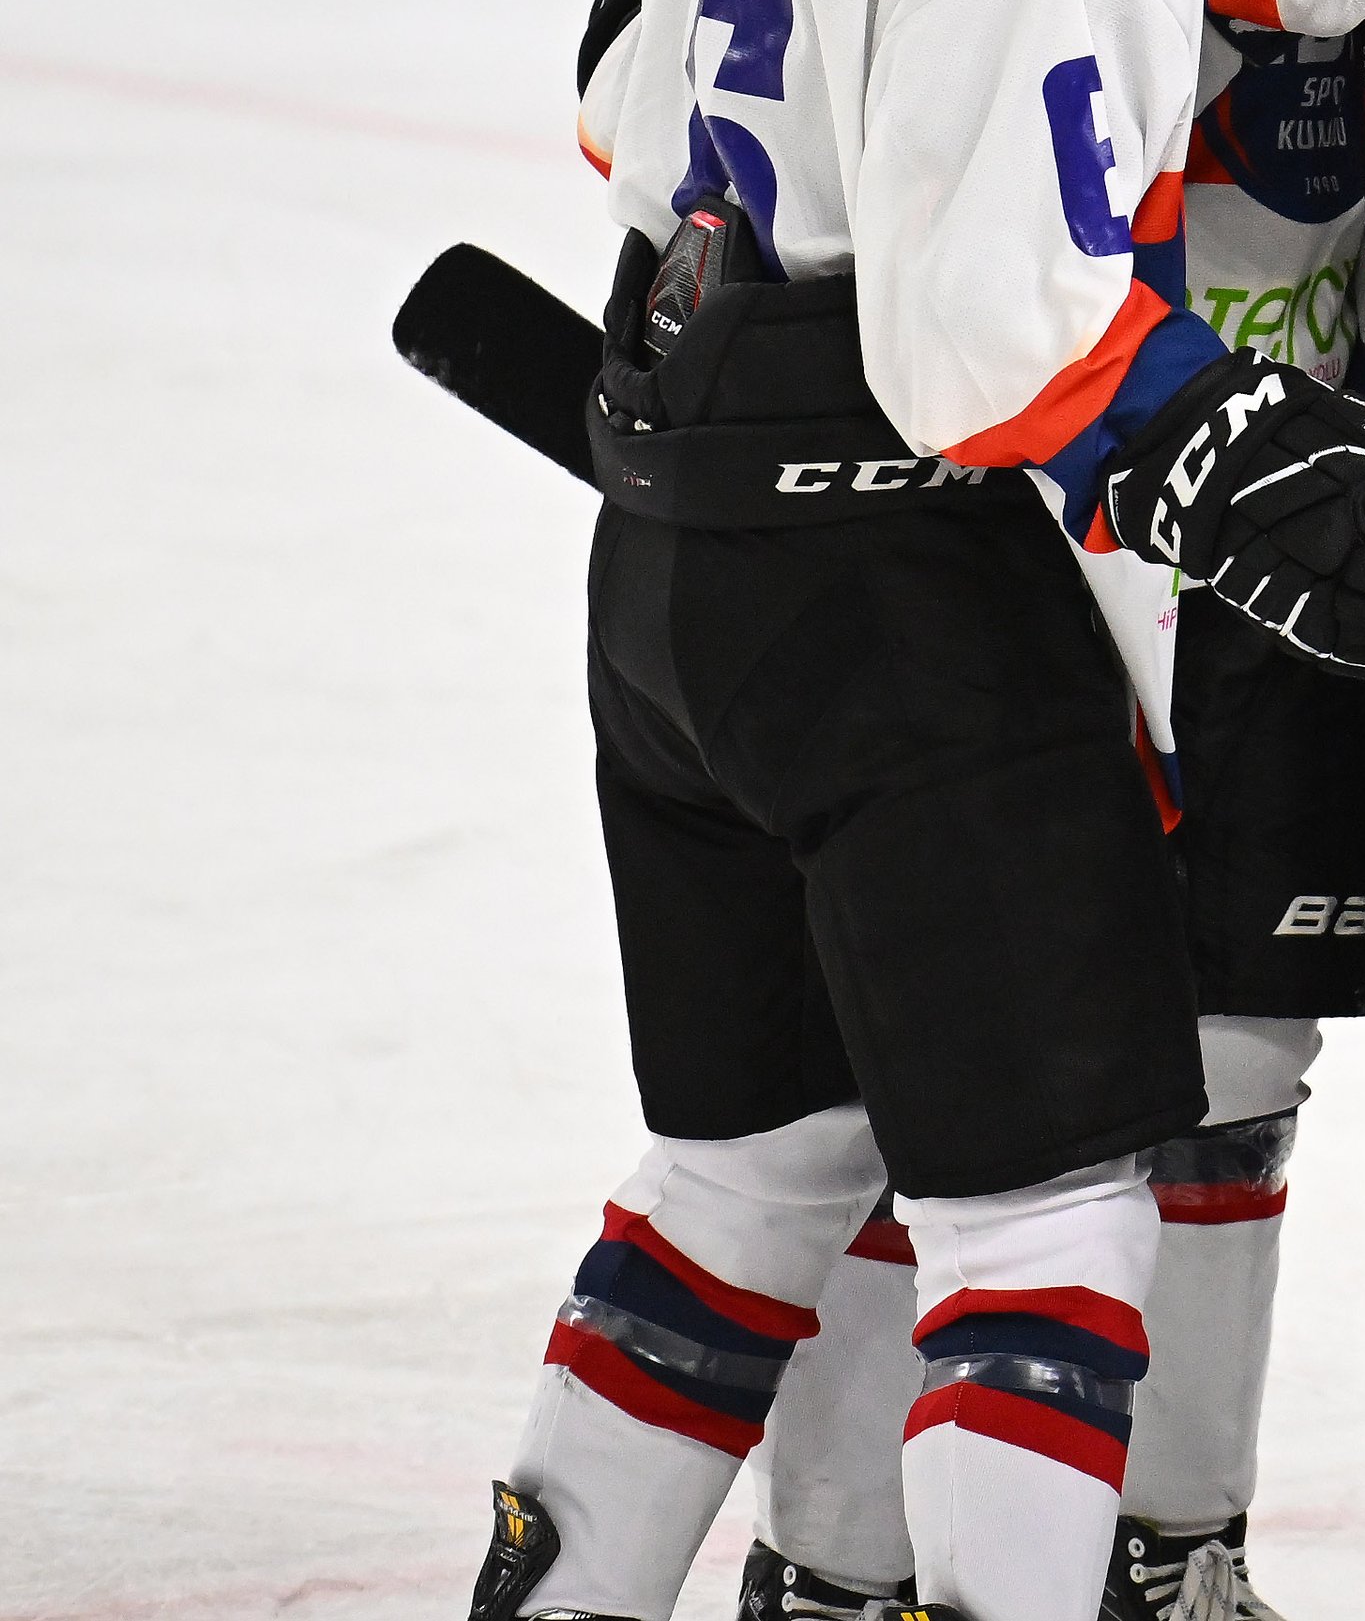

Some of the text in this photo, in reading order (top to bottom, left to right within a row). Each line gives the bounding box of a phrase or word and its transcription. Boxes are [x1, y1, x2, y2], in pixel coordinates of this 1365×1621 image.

[652, 310, 683, 336] CCM
[774, 457, 990, 494] CCM
[1149, 372, 1287, 564] CCM
